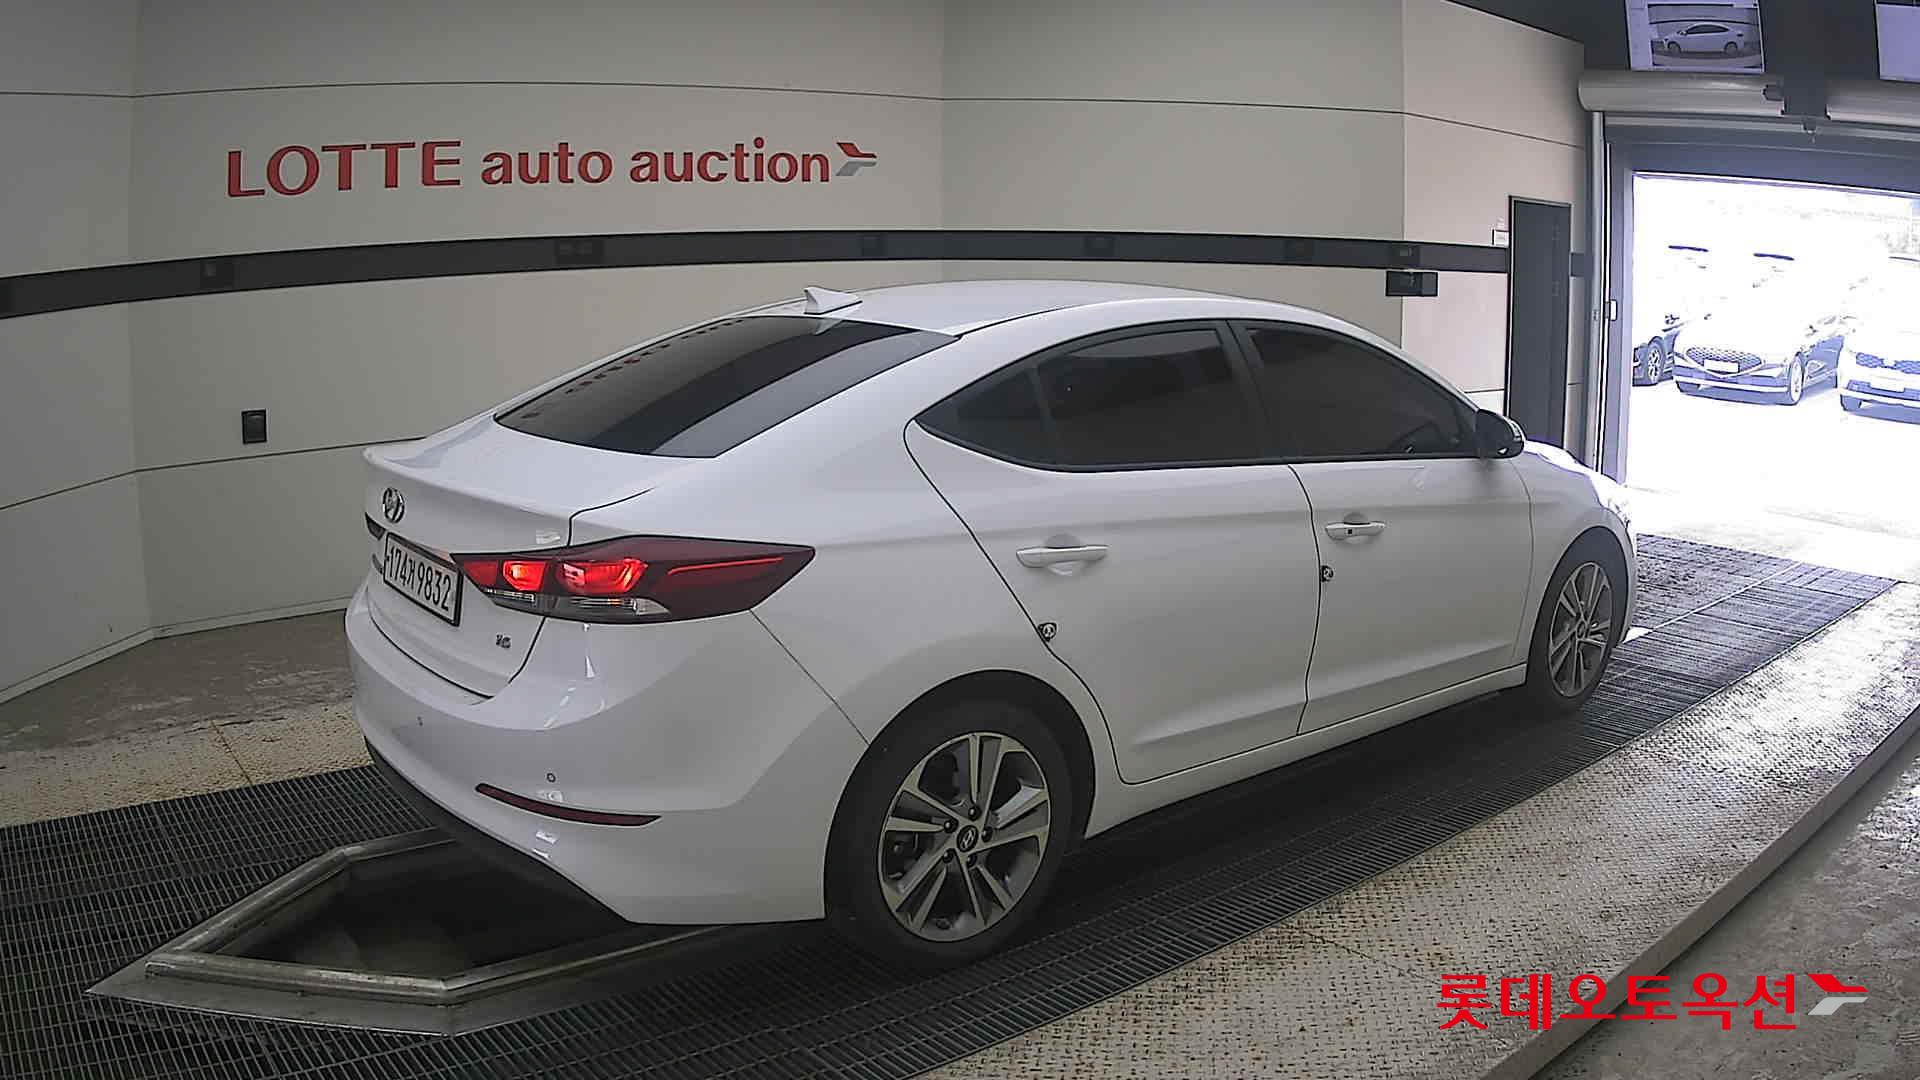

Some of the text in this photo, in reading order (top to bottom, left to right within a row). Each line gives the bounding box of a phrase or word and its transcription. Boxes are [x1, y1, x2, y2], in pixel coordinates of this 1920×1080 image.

[227, 137, 830, 197] LOTTE auto auction
